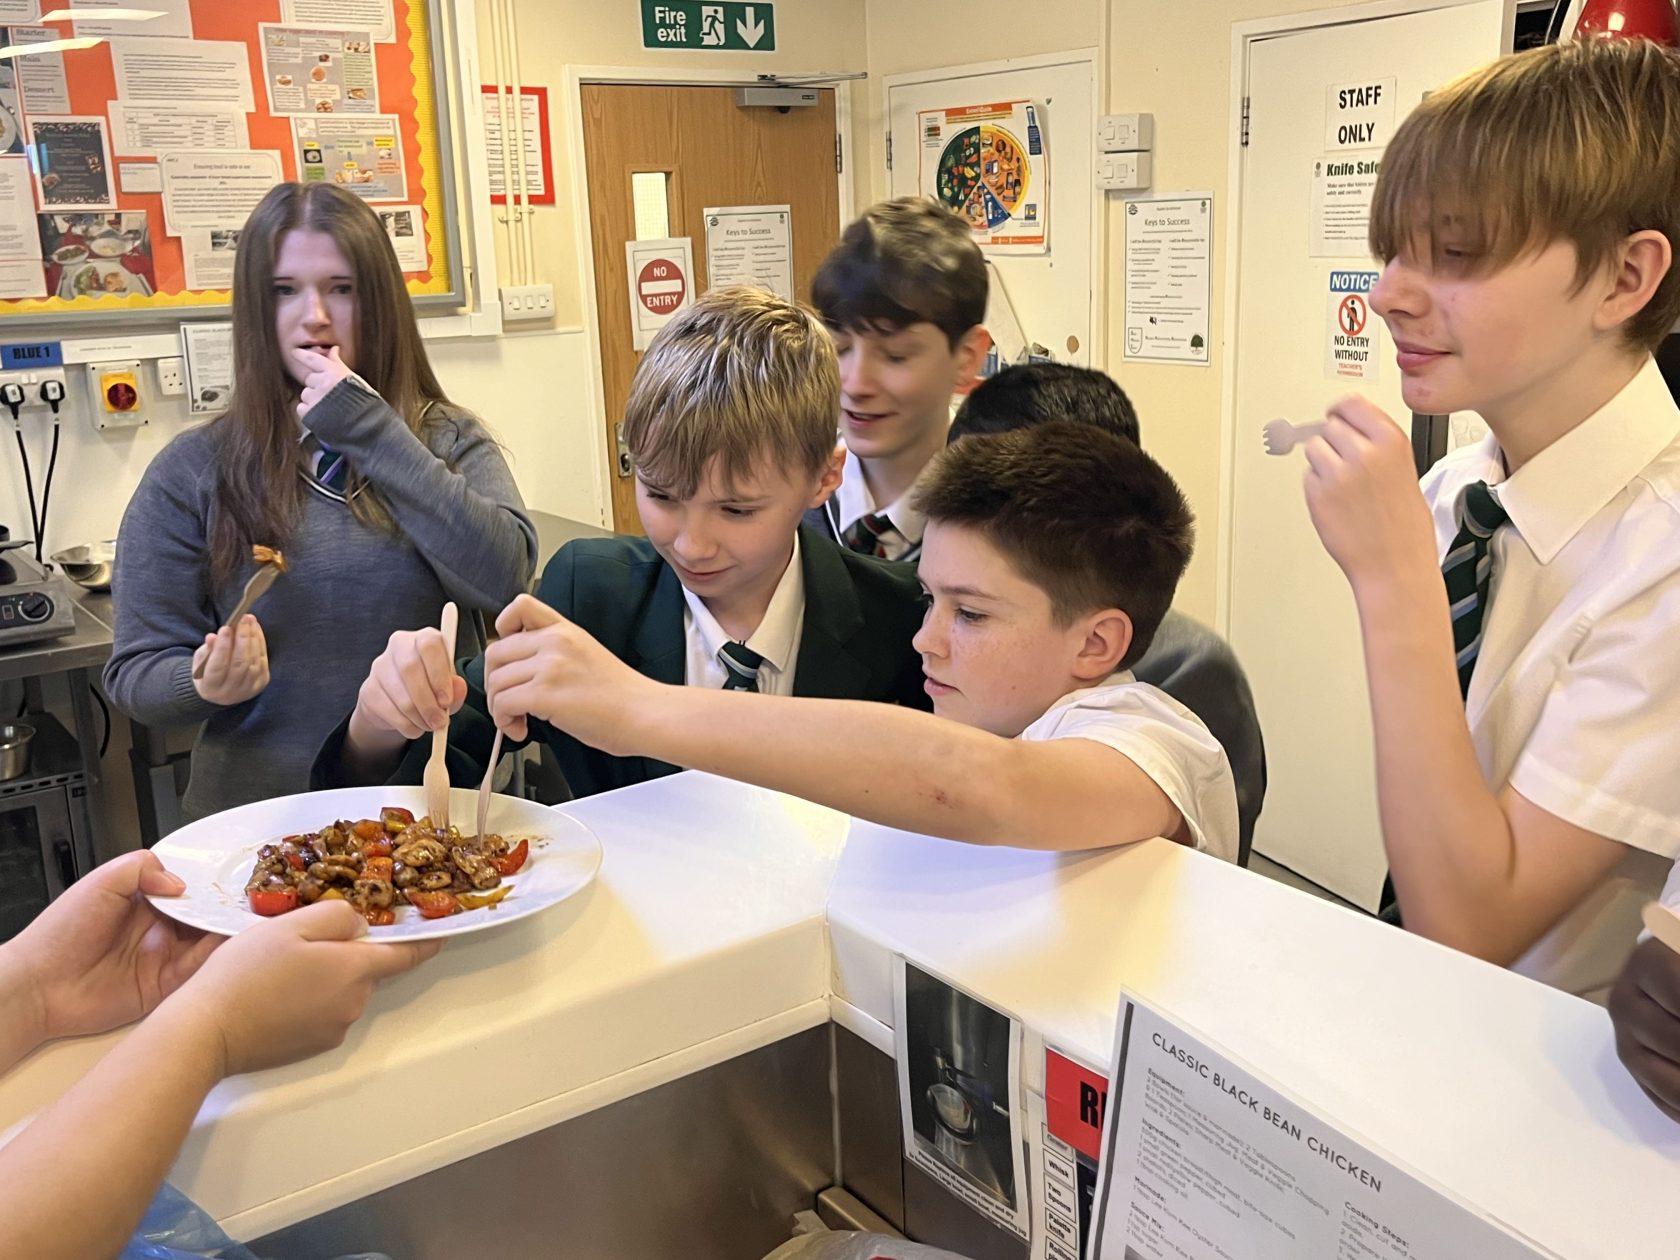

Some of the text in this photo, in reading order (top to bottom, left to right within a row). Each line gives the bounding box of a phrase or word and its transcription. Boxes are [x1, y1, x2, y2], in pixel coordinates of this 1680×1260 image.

[655, 6, 686, 25] Fire
[657, 25, 687, 42] exit
[1339, 85, 1382, 109] STAFF
[1338, 123, 1375, 144] ONLY
[1326, 161, 1381, 177] Knife Safe
[1144, 219, 1158, 227] Keys
[1167, 218, 1190, 226] Success
[726, 229, 740, 237] Keys
[653, 266, 667, 277] NO
[646, 293, 679, 307] ENTRY
[1334, 335, 1370, 348] NO ENTRY
[13, 346, 50, 360] BLUE 1
[1334, 349, 1369, 362] WITHOUT
[1148, 1067, 1184, 1096] Equipment:
[1080, 1081, 1108, 1131] R
[1152, 1032, 1382, 1193] CLASSIC BLACK BEAN CHICKEN
[1142, 1117, 1180, 1147] Ingredients:
[1048, 1159, 1069, 1178] Whisk
[1048, 1182, 1061, 1196] Two
[1048, 1192, 1072, 1213] Spoons
[1049, 1213, 1071, 1234] Palette
[1131, 1201, 1165, 1231] Sauce Mix:
[1345, 1201, 1409, 1248] Cooking Steps:
[1049, 1222, 1065, 1239] knife
[1391, 1242, 1407, 1258] and
